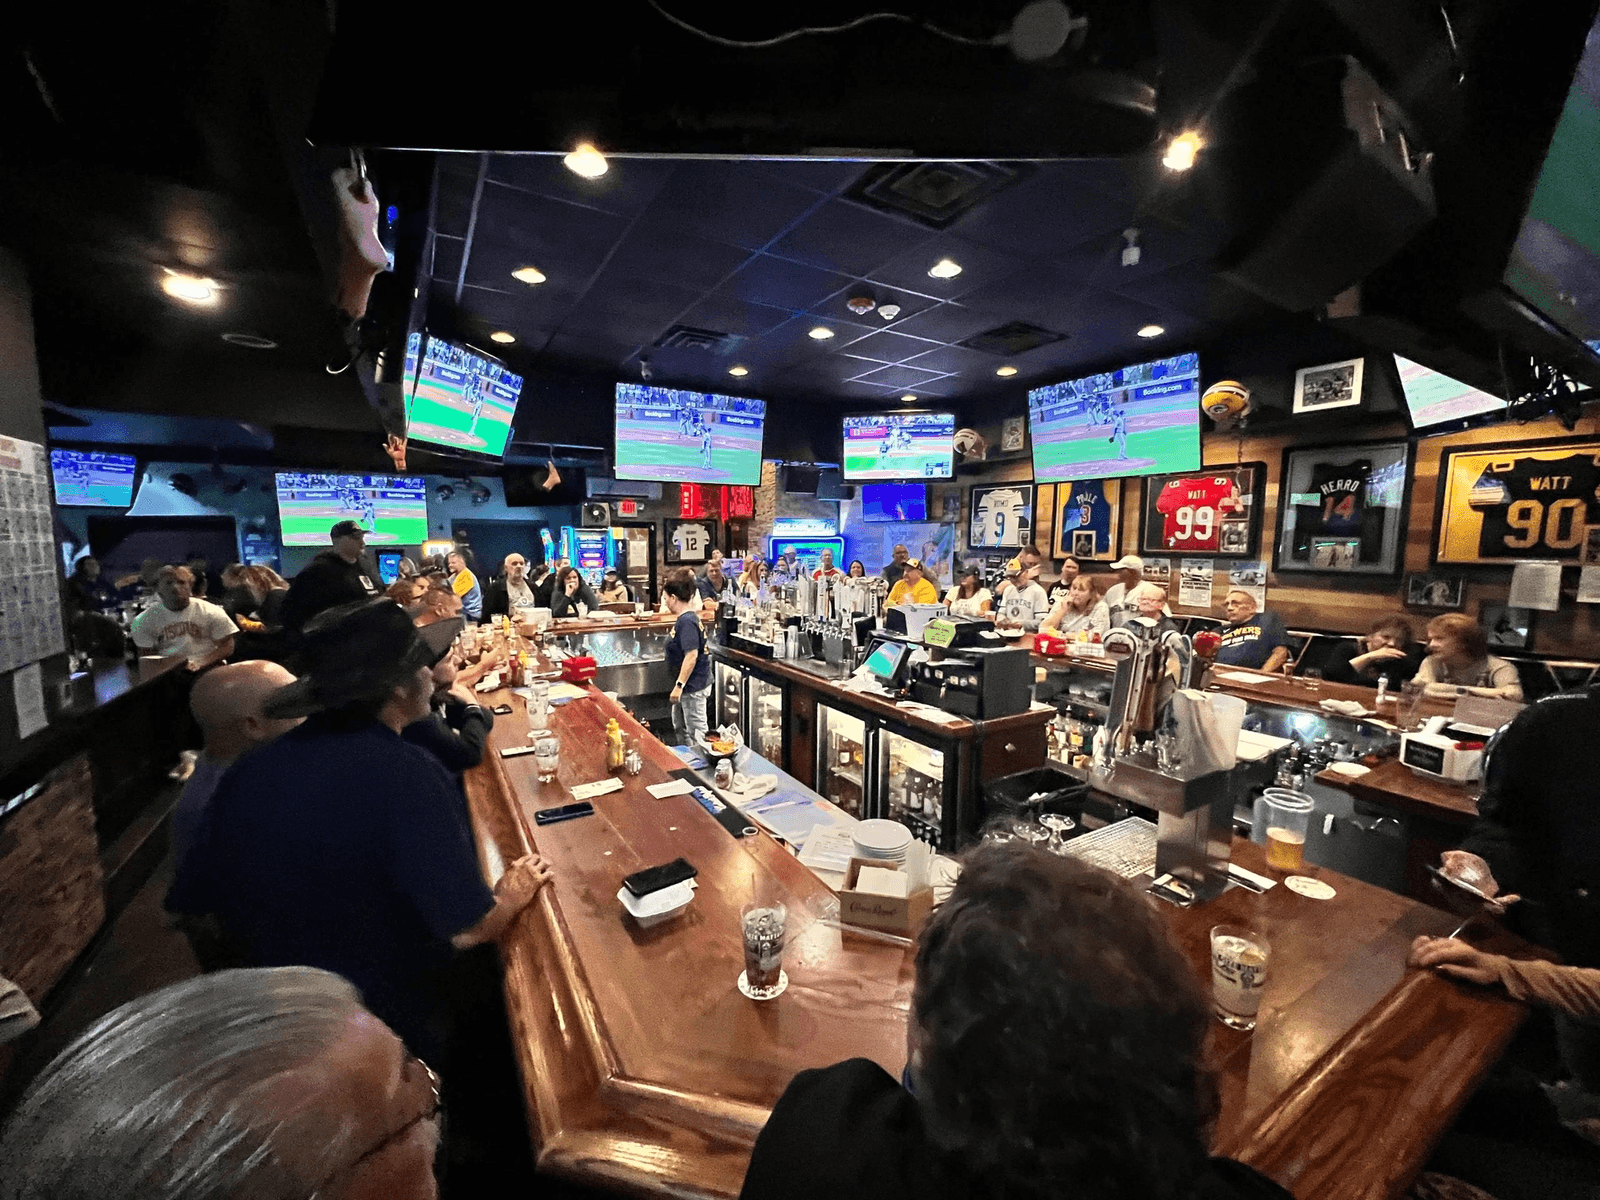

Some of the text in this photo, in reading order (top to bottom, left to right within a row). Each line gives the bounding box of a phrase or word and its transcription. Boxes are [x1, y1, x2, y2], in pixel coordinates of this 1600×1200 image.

[1142, 384, 1183, 396] Booking.com
[1320, 479, 1360, 495] HERRO
[1530, 475, 1572, 490] WATT
[1187, 490, 1206, 499] WATT
[1080, 504, 1092, 526] 3
[1321, 493, 1356, 521] 14
[994, 511, 1006, 538] 9
[1174, 506, 1214, 540] 99
[1503, 498, 1587, 549] 90
[685, 537, 698, 551] 12
